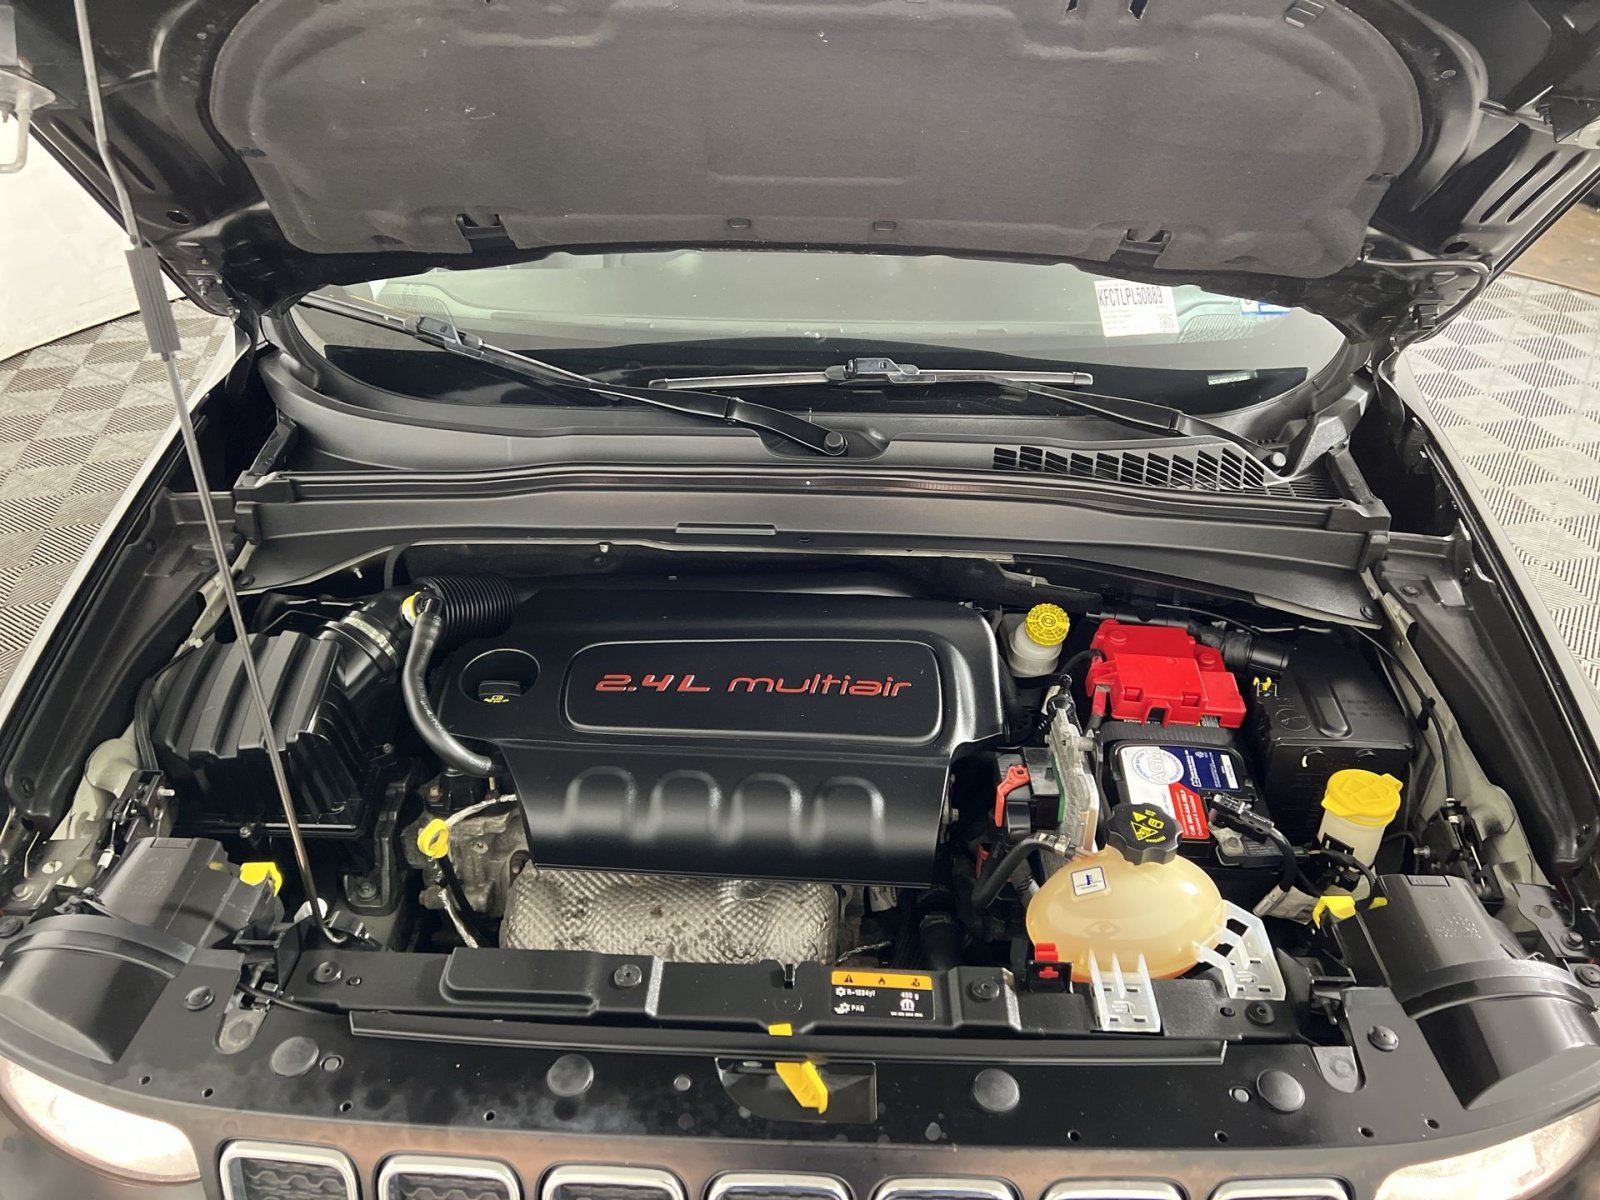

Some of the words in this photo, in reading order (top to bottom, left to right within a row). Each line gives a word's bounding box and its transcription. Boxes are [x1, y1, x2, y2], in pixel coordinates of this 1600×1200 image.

[1097, 286, 1163, 307] KFCTLPL50889
[595, 674, 711, 693] 2.4L
[727, 673, 912, 697] multiair
